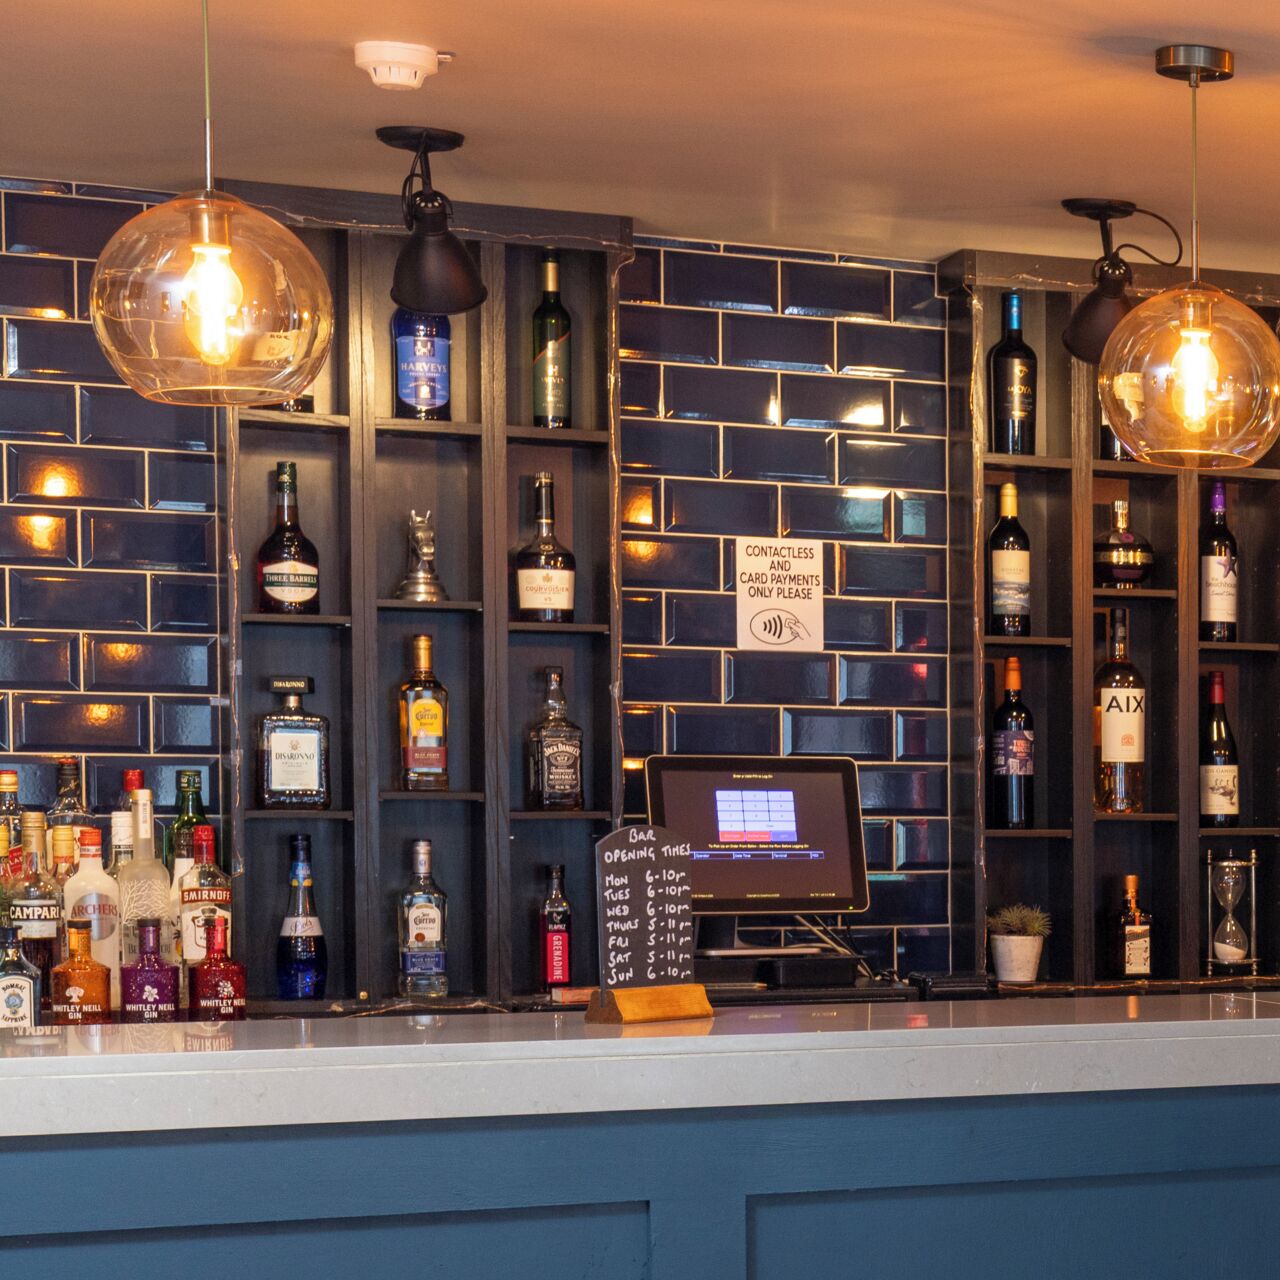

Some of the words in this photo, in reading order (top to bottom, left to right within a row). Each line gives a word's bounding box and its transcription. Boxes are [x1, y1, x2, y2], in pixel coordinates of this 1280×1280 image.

[401, 362, 447, 373] HARVEYS
[745, 544, 815, 559] CONTACTLESS
[769, 560, 791, 572] AND
[266, 574, 288, 582] THREE
[289, 575, 317, 583] BARRELS
[740, 571, 768, 585] CARD
[770, 573, 821, 587] PAYMENTS
[748, 586, 774, 598] ONLY
[776, 587, 813, 600] PLEASE
[1105, 695, 1144, 713] AIX
[275, 752, 315, 760] DISARONNO
[544, 745, 558, 757] JACK
[629, 828, 656, 844] BAR
[604, 847, 656, 863] OPENING
[661, 843, 690, 858] TIMES
[605, 873, 628, 887] MON
[184, 889, 232, 902] SMIRNOFF
[603, 888, 630, 901] TUES
[9, 903, 60, 920] CAMPARI
[70, 903, 119, 917] ARCHERS
[606, 905, 629, 917] WED
[606, 918, 639, 933] THURS
[608, 935, 629, 950] FRI
[552, 935, 563, 980] GRENADINE
[608, 951, 632, 968] SAT
[607, 967, 633, 985] SUN
[53, 1004, 81, 1013] WHITLEY
[82, 1004, 102, 1012] NEILL
[126, 1003, 157, 1012] WHITLEY
[158, 1002, 175, 1011] NEILL
[200, 999, 232, 1007] WHITLEY
[68, 1012, 82, 1020] GIN
[144, 1010, 158, 1019] GIN
[220, 1006, 233, 1014] GIN
